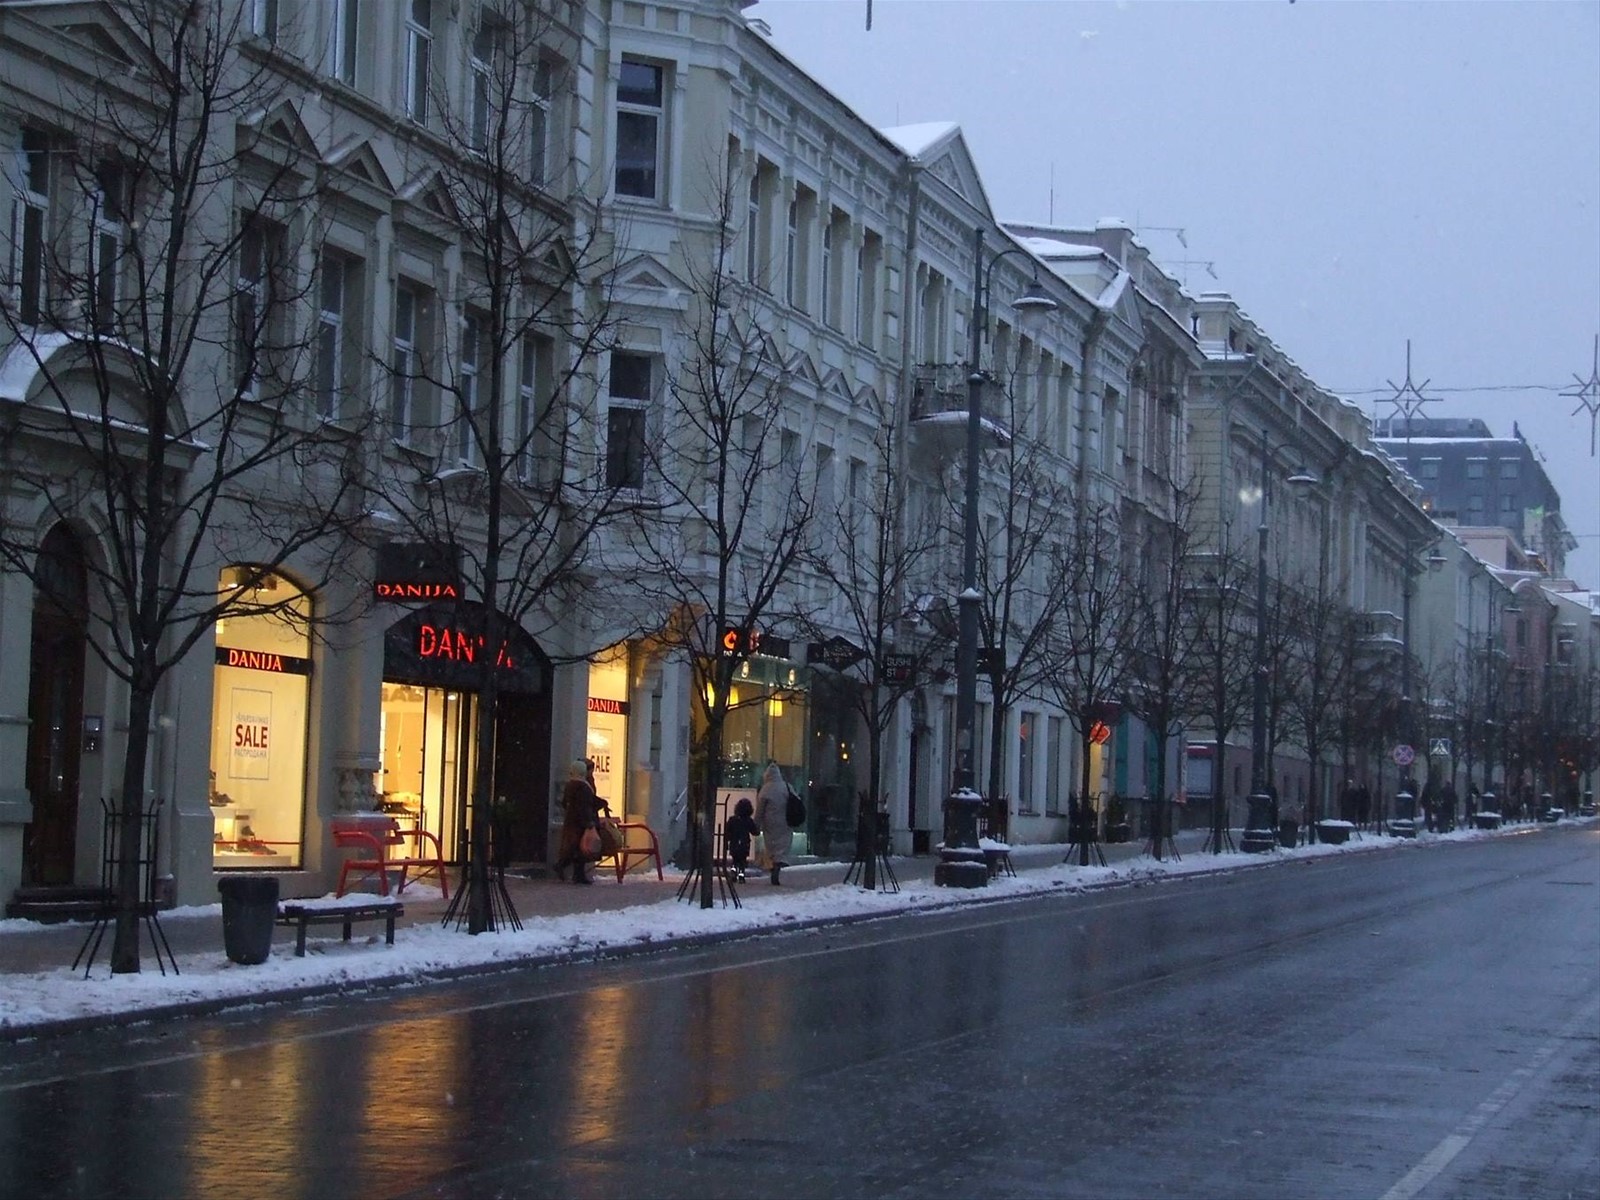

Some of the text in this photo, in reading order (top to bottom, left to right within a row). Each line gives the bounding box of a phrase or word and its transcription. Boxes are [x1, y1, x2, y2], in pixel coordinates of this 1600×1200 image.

[377, 583, 456, 597] DANIJA
[228, 649, 282, 671] DANIJA
[588, 698, 620, 713] DANIJA
[235, 724, 268, 748] SALE
